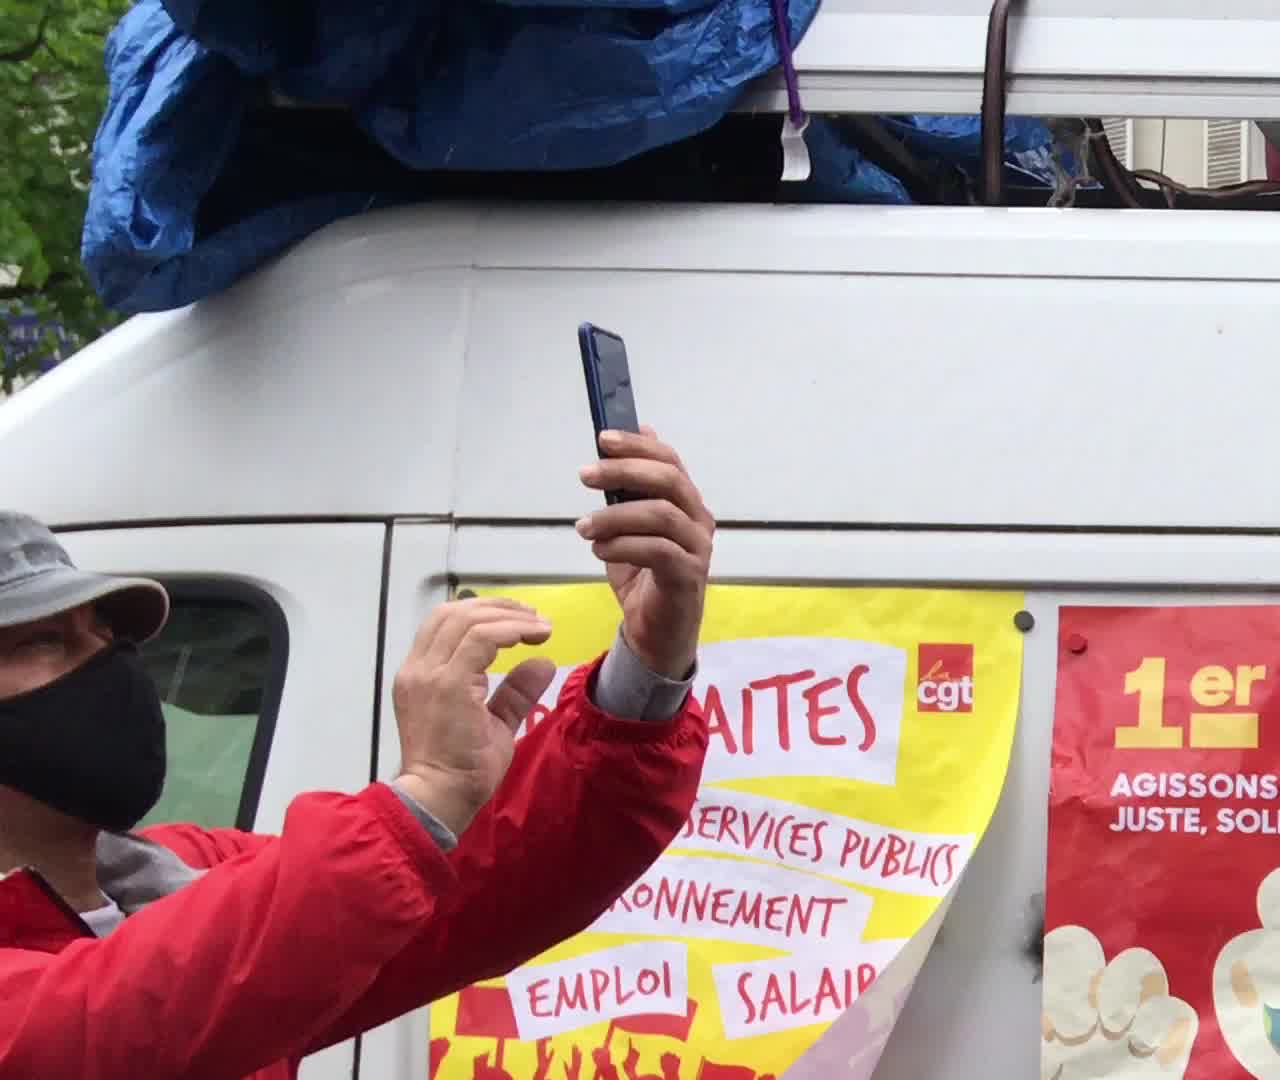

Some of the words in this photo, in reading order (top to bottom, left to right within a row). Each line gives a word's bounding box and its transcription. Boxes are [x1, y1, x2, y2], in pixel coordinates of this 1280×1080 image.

[917, 676, 975, 711] cgt
[1114, 656, 1267, 749] 1er
[1110, 773, 1278, 799] AGISSONS
[1109, 806, 1208, 836] JUSTE,
[841, 828, 960, 886] PUBLICS
[526, 961, 672, 1018] EMPLOI
